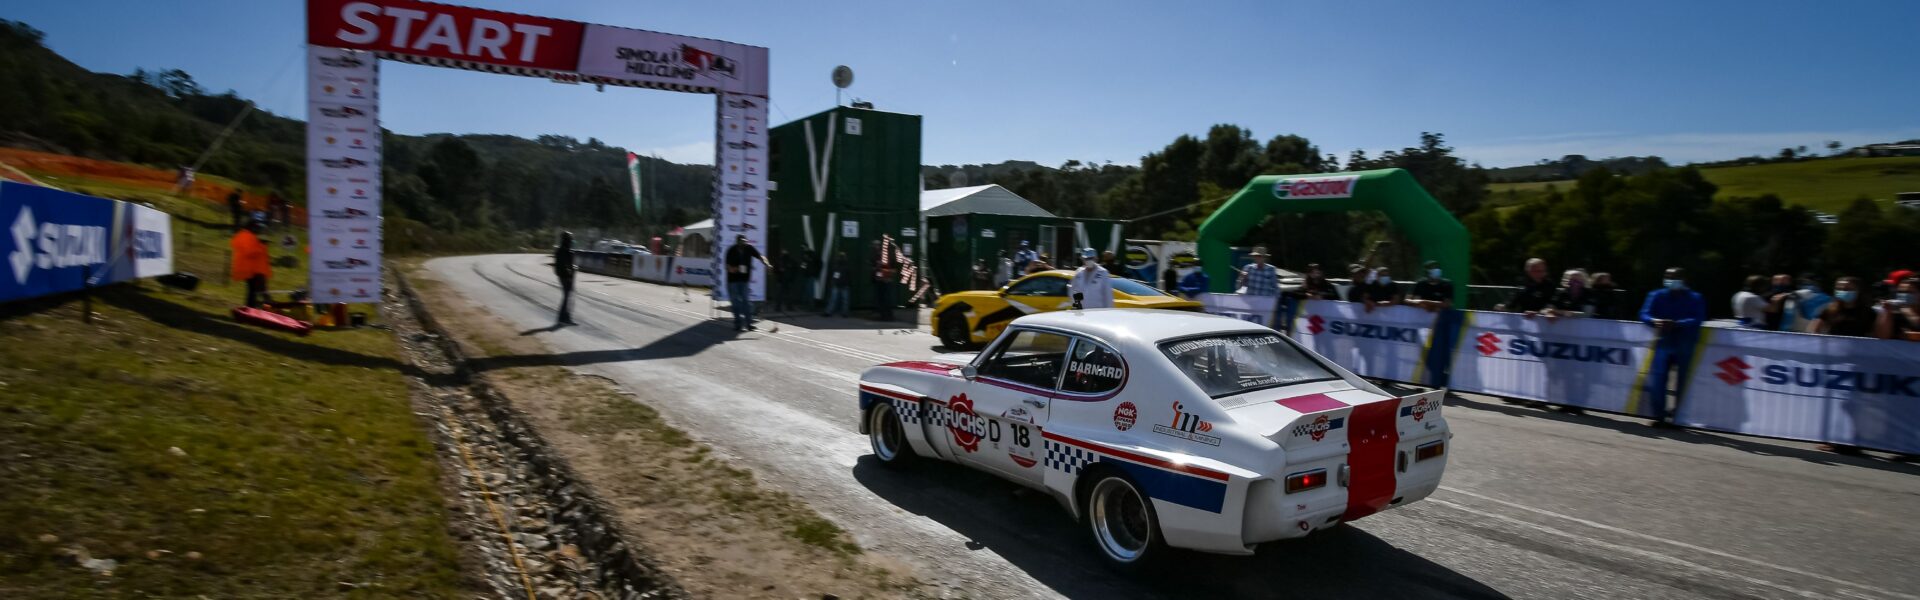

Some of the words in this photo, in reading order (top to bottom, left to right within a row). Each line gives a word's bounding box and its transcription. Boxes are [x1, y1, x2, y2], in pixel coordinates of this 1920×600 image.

[336, 1, 552, 63] START
[616, 47, 671, 63] SIMOLA
[626, 62, 695, 80] HILLCLIMB
[1329, 320, 1418, 344] SUZUKI
[1508, 338, 1631, 366] SUZUKI
[1070, 361, 1123, 380] BARNARD
[944, 407, 986, 439] FUCHS
[1118, 407, 1135, 418] NGK
[989, 418, 1001, 443] D
[1010, 422, 1031, 449] 18
[1311, 420, 1331, 432] FUCHS
